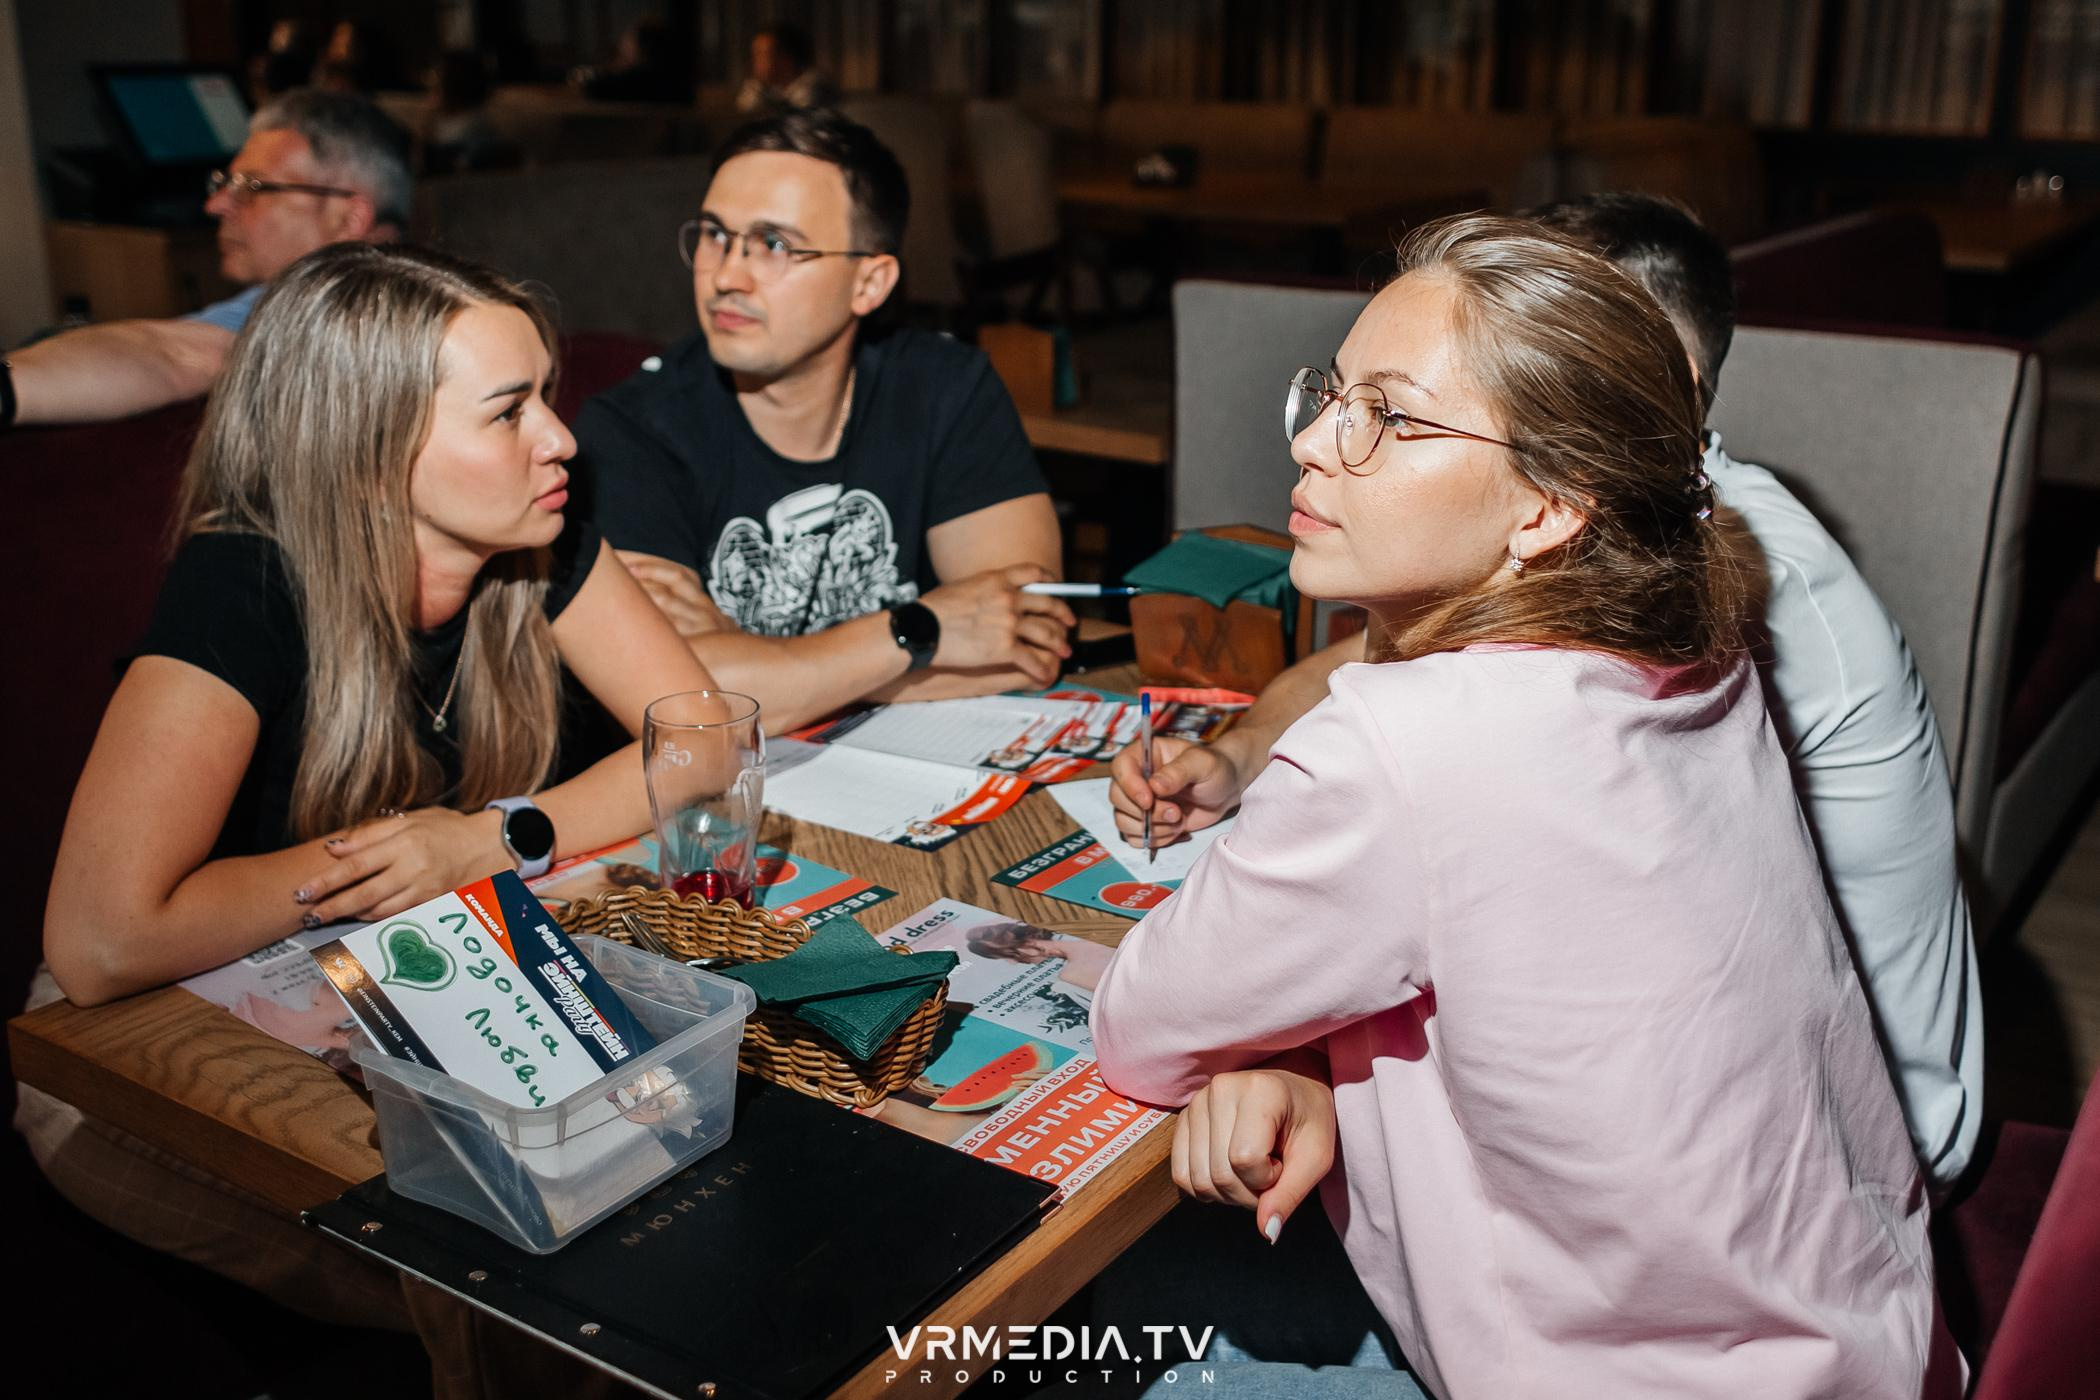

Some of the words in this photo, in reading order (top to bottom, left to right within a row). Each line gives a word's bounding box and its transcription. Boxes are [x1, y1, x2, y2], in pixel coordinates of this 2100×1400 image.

[1008, 832, 1095, 879] БЕЗГРАН
[464, 893, 504, 938] КОМАНДА
[904, 909, 954, 938] dress
[534, 923, 568, 956] МЫ
[560, 953, 588, 983] НА
[438, 912, 559, 1057] Лодочка
[979, 974, 1028, 1005] свадебные
[992, 981, 1035, 1009] вечерние
[554, 995, 594, 1036] party
[1047, 1058, 1091, 1086] ВХОД
[1078, 1136, 1133, 1179] ПЯТНИЦУ
[1129, 1128, 1142, 1137] И
[619, 1162, 751, 1247] МЮНХЕН
